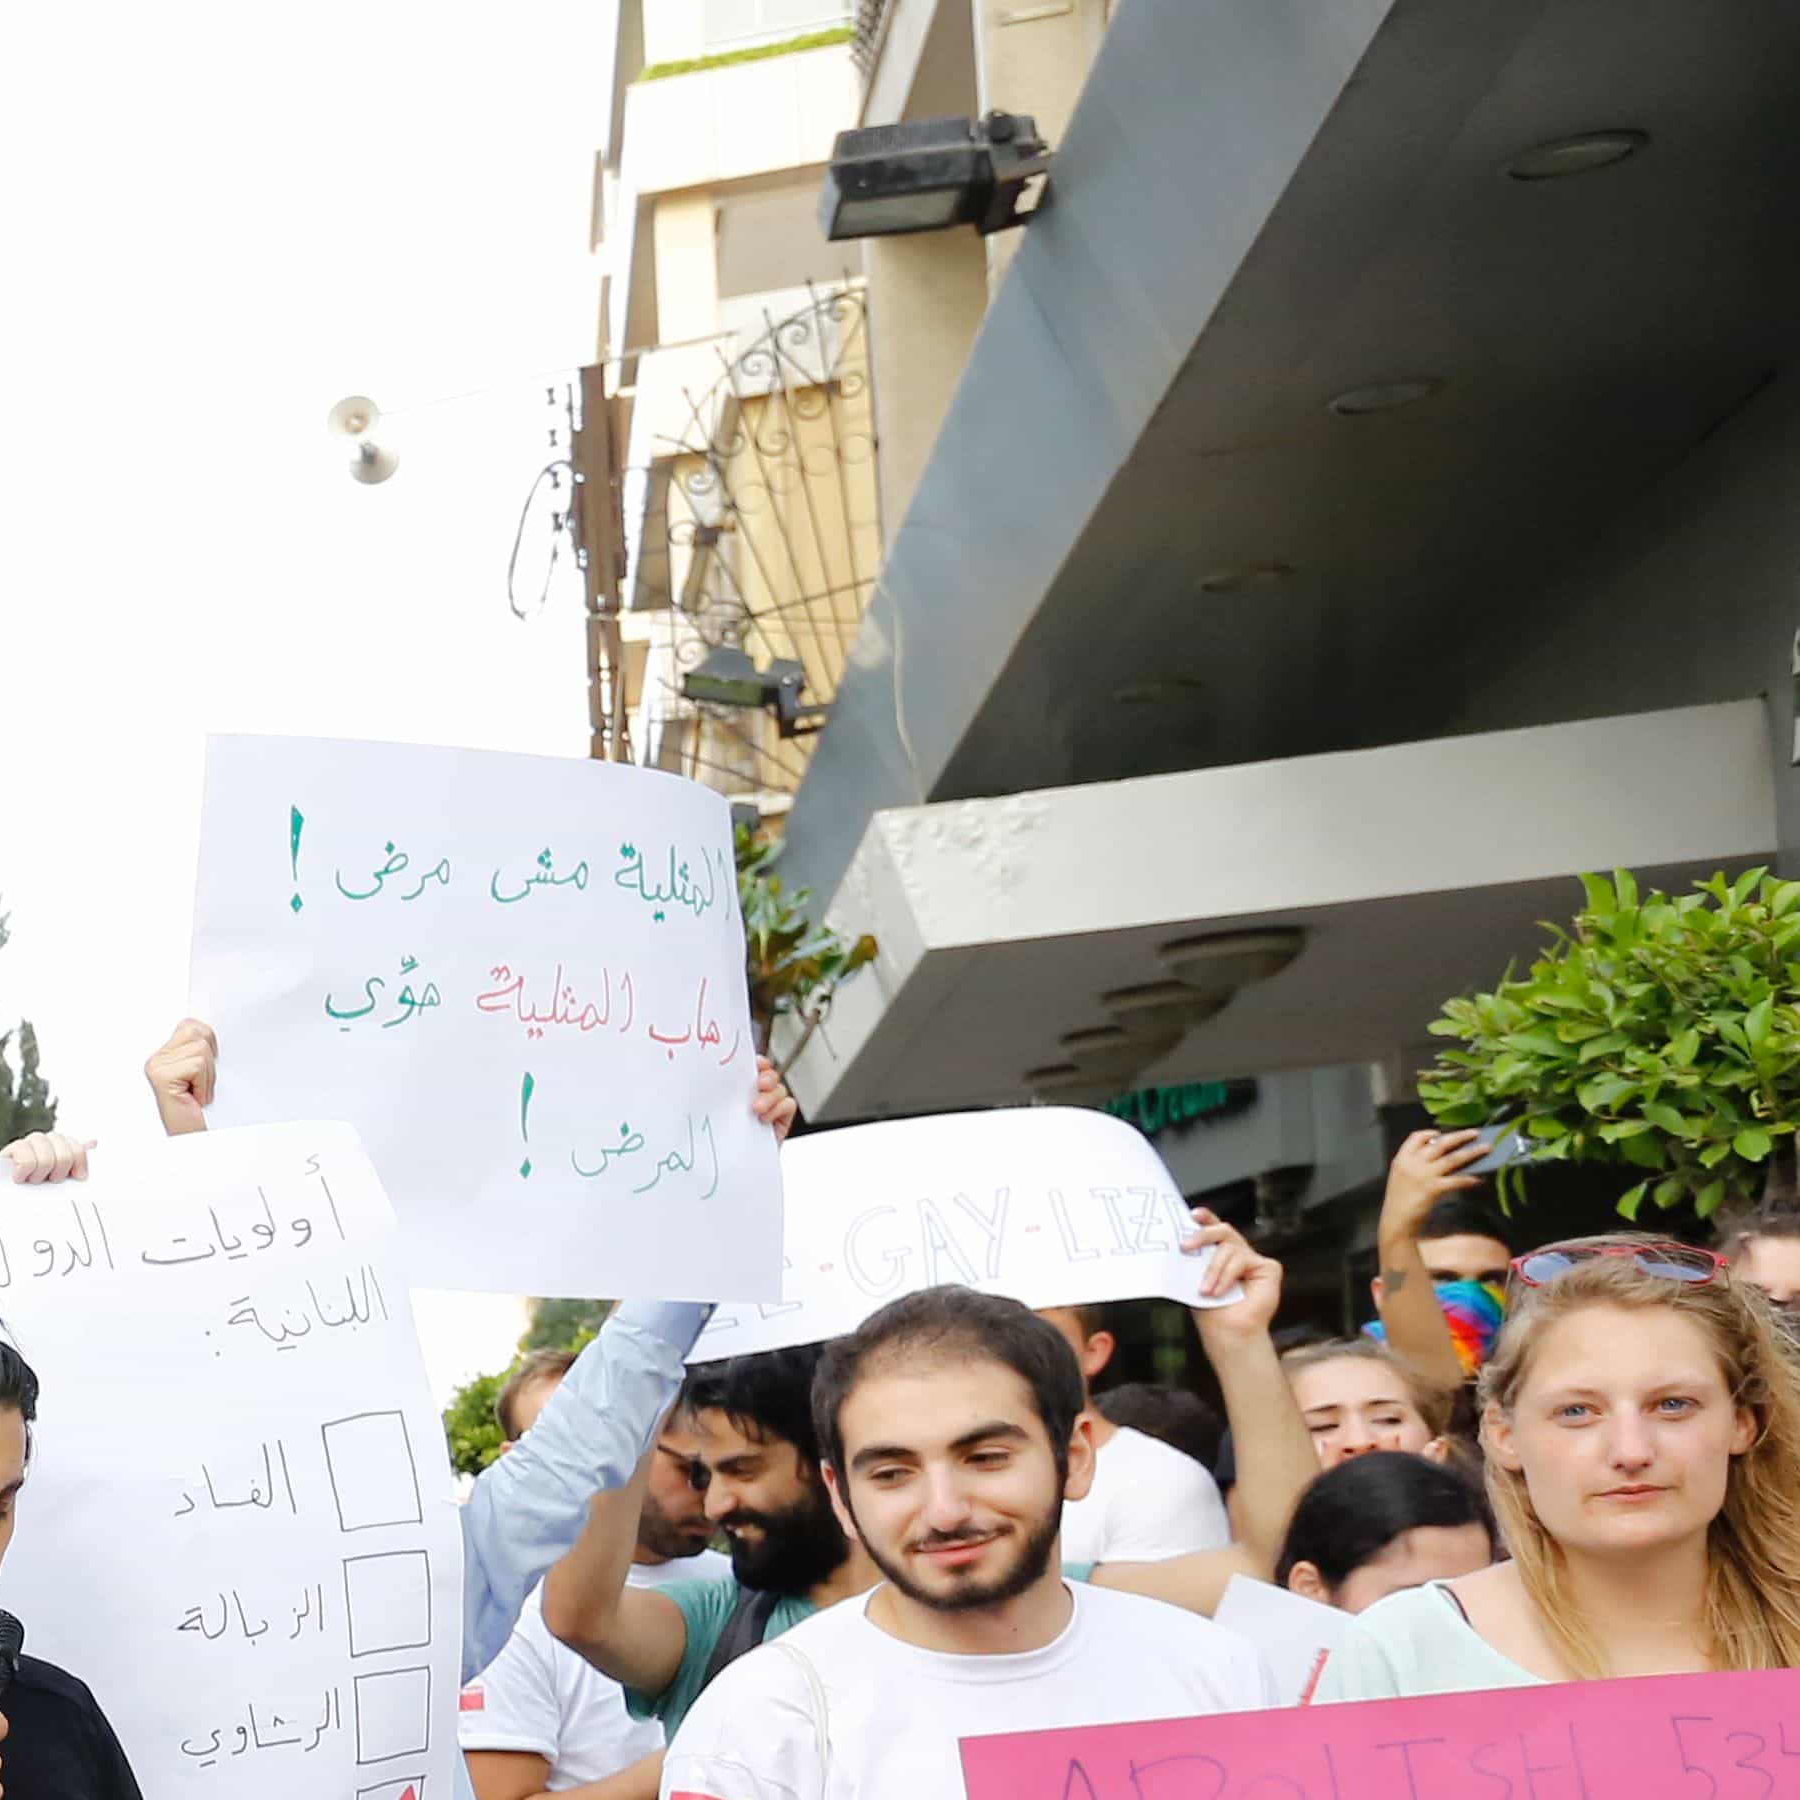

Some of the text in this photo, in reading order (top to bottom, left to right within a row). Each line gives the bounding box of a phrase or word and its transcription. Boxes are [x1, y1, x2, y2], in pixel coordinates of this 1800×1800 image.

[335, 841, 452, 901] مرض
[491, 846, 590, 903] مش
[614, 842, 731, 921] المثلية
[475, 962, 634, 1040] المثلية
[648, 977, 740, 1066] رهاب
[572, 1113, 720, 1200] المرض
[141, 1153, 346, 1265] أولويات
